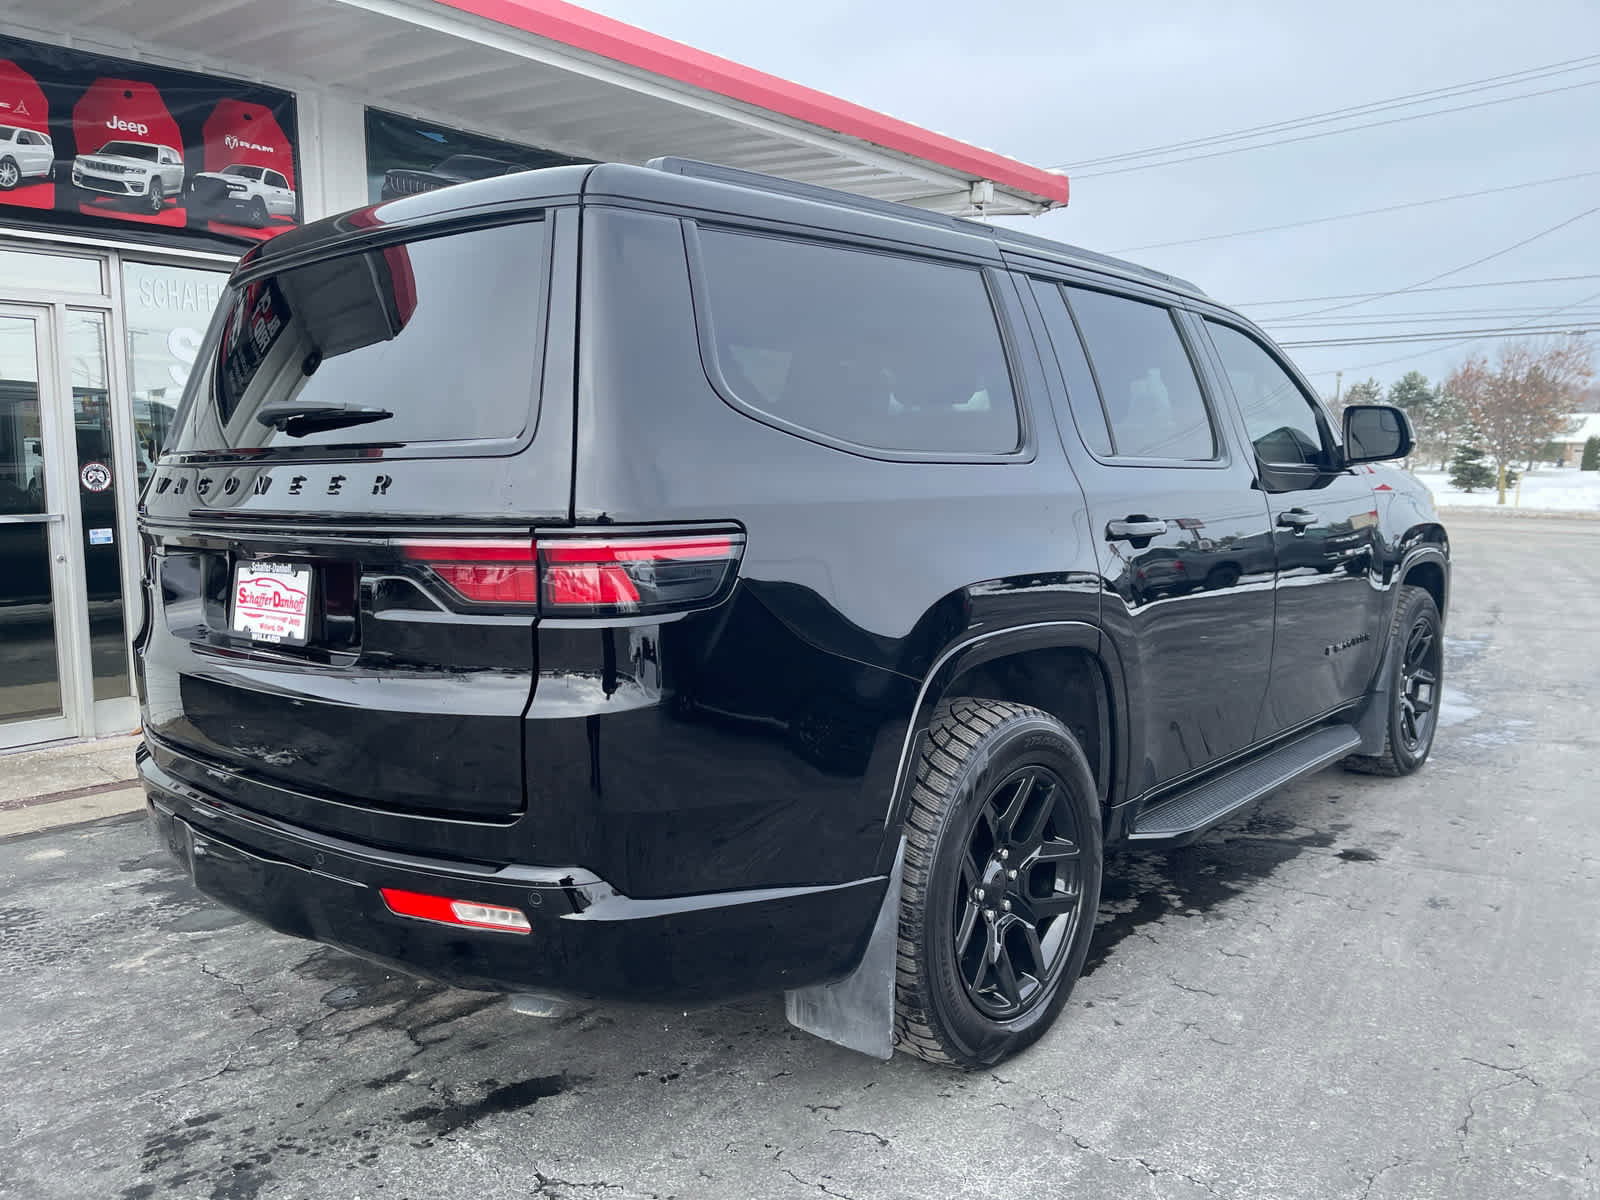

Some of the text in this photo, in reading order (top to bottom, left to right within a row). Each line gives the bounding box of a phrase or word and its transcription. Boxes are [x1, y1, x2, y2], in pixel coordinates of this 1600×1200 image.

[106, 115, 148, 136] Jeep
[239, 141, 274, 152] RAM
[155, 474, 393, 496] WAGONEER
